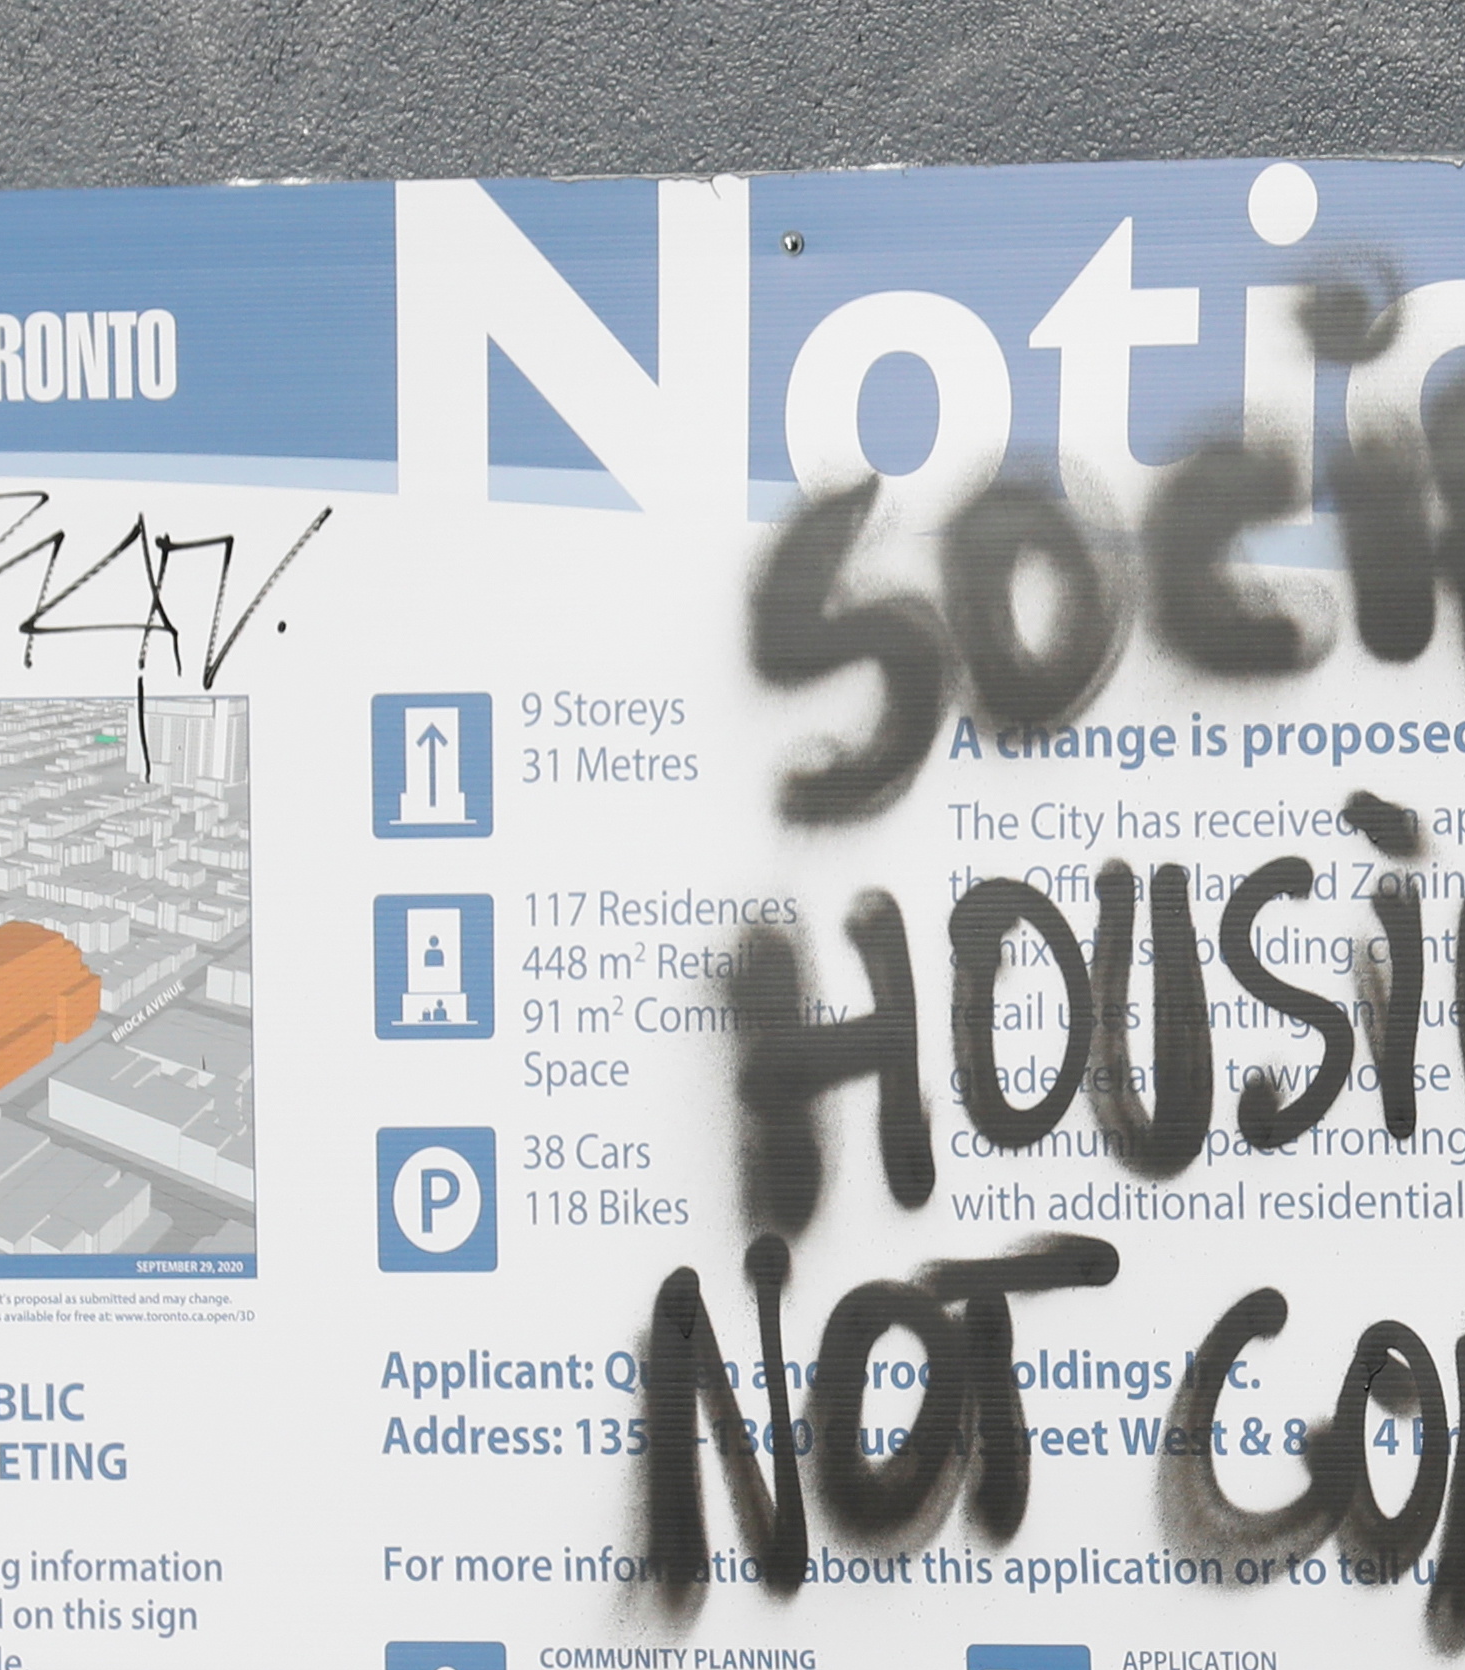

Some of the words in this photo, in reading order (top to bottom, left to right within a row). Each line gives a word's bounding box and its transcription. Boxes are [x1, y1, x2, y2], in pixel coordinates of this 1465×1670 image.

[522, 691, 542, 727] 9
[553, 689, 685, 735] Storeys
[948, 717, 982, 760] A
[996, 718, 1177, 771] change
[1191, 712, 1228, 757] is
[522, 748, 559, 784] 31
[576, 746, 699, 783] Metres
[948, 800, 1019, 841] The
[1030, 801, 1105, 851] City
[1116, 800, 1181, 840] has
[524, 892, 587, 928] 117
[599, 888, 798, 928] Residences
[522, 945, 588, 981] 448
[110, 1009, 147, 1043] BROCK
[144, 979, 186, 1016] AVENUE
[522, 998, 560, 1034] 91
[523, 1052, 630, 1095] Space
[523, 1135, 564, 1169] 38
[575, 1134, 651, 1169] Cars
[525, 1189, 588, 1225] 118
[599, 1187, 690, 1225] Bikes
[951, 1182, 1035, 1221] with
[1048, 1181, 1245, 1221] additional
[1259, 1180, 1463, 1221] residential
[135, 1260, 197, 1274] SEPTEMBER
[199, 1260, 216, 1276] 29,
[217, 1260, 244, 1274] 2020
[3, 1310, 53, 1323] available
[55, 1309, 72, 1323] for
[74, 1309, 96, 1323] free
[98, 1310, 113, 1322] at:
[114, 1309, 255, 1324] www.toronto.ca.open/3D
[14, 1292, 62, 1307] proposal
[65, 1295, 77, 1305] as
[79, 1292, 136, 1305] submitted
[139, 1292, 160, 1305] and
[162, 1294, 186, 1308] may
[188, 1292, 233, 1307] change.
[381, 1349, 594, 1400] Applicant:
[979, 1349, 1172, 1400] oldings
[382, 1414, 562, 1456] Address:
[576, 1418, 673, 1456] 135
[1239, 1417, 1272, 1456] &
[630, 1240, 1121, 1630] NOT
[30, 1549, 224, 1583] information
[384, 1546, 444, 1582] For
[456, 1554, 552, 1582] more
[804, 1546, 911, 1584] about
[922, 1547, 992, 1584] this
[1004, 1546, 1222, 1594] application
[1234, 1556, 1275, 1586] or
[1286, 1551, 1327, 1585] to
[13, 1605, 53, 1631] on
[64, 1598, 122, 1631] this
[131, 1600, 199, 1639] sign
[538, 1647, 689, 1670] COMMUNITY
[694, 1647, 817, 1670] PLANNING
